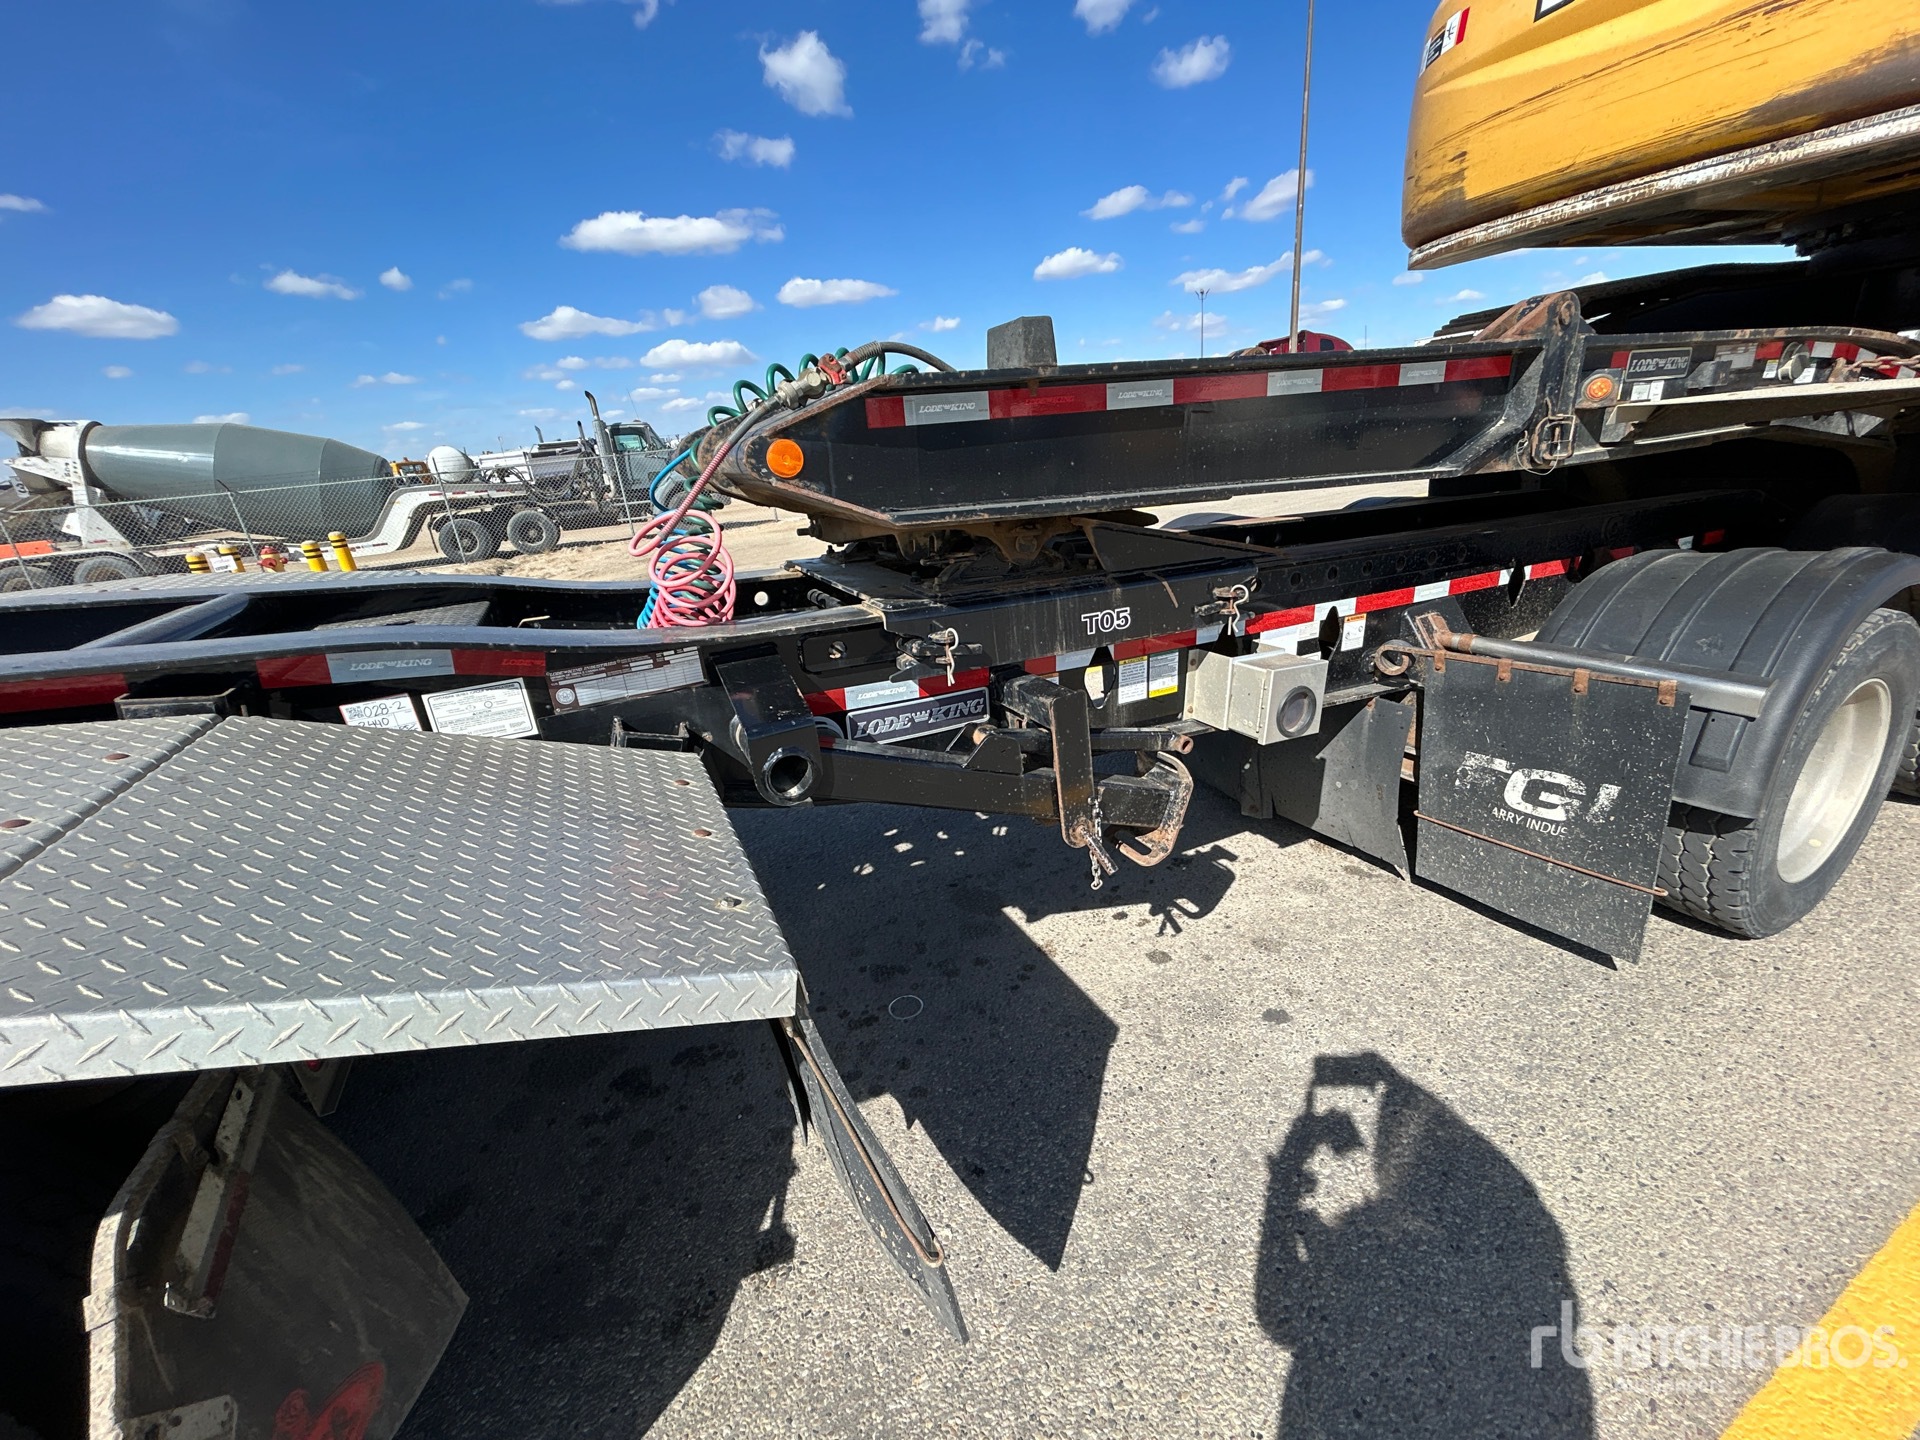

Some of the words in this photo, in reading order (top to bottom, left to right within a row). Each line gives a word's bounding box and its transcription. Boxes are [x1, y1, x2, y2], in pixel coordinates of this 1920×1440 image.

[1081, 607, 1131, 635] T05
[854, 713, 912, 739] LODE
[928, 697, 985, 724] KING
